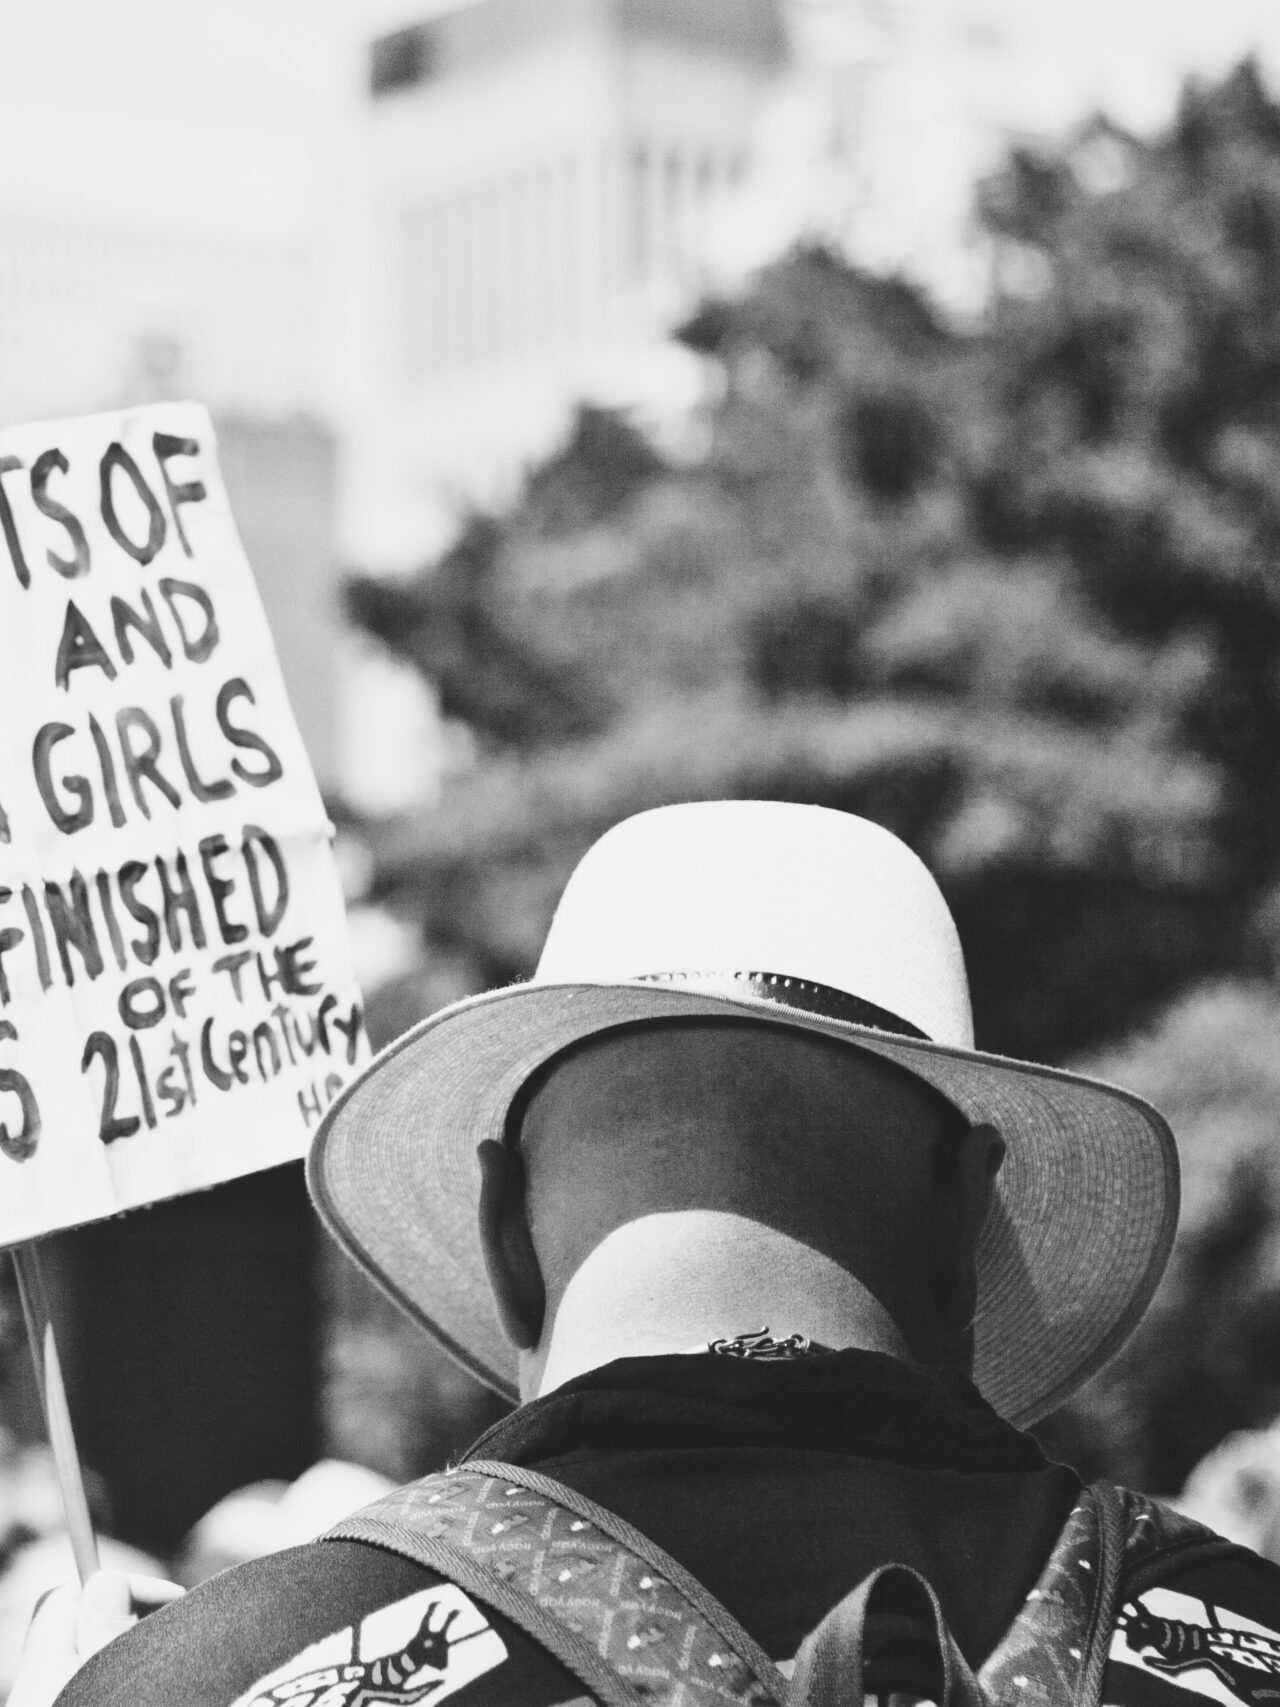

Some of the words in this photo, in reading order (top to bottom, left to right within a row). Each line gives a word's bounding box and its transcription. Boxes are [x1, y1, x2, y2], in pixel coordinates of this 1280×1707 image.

[100, 432, 207, 566] OF
[55, 577, 220, 692] AND
[32, 677, 283, 835] GIRLS
[119, 968, 197, 1030] OF
[211, 936, 324, 1003] THE
[81, 1029, 198, 1145] 21st
[201, 994, 364, 1091] Century
